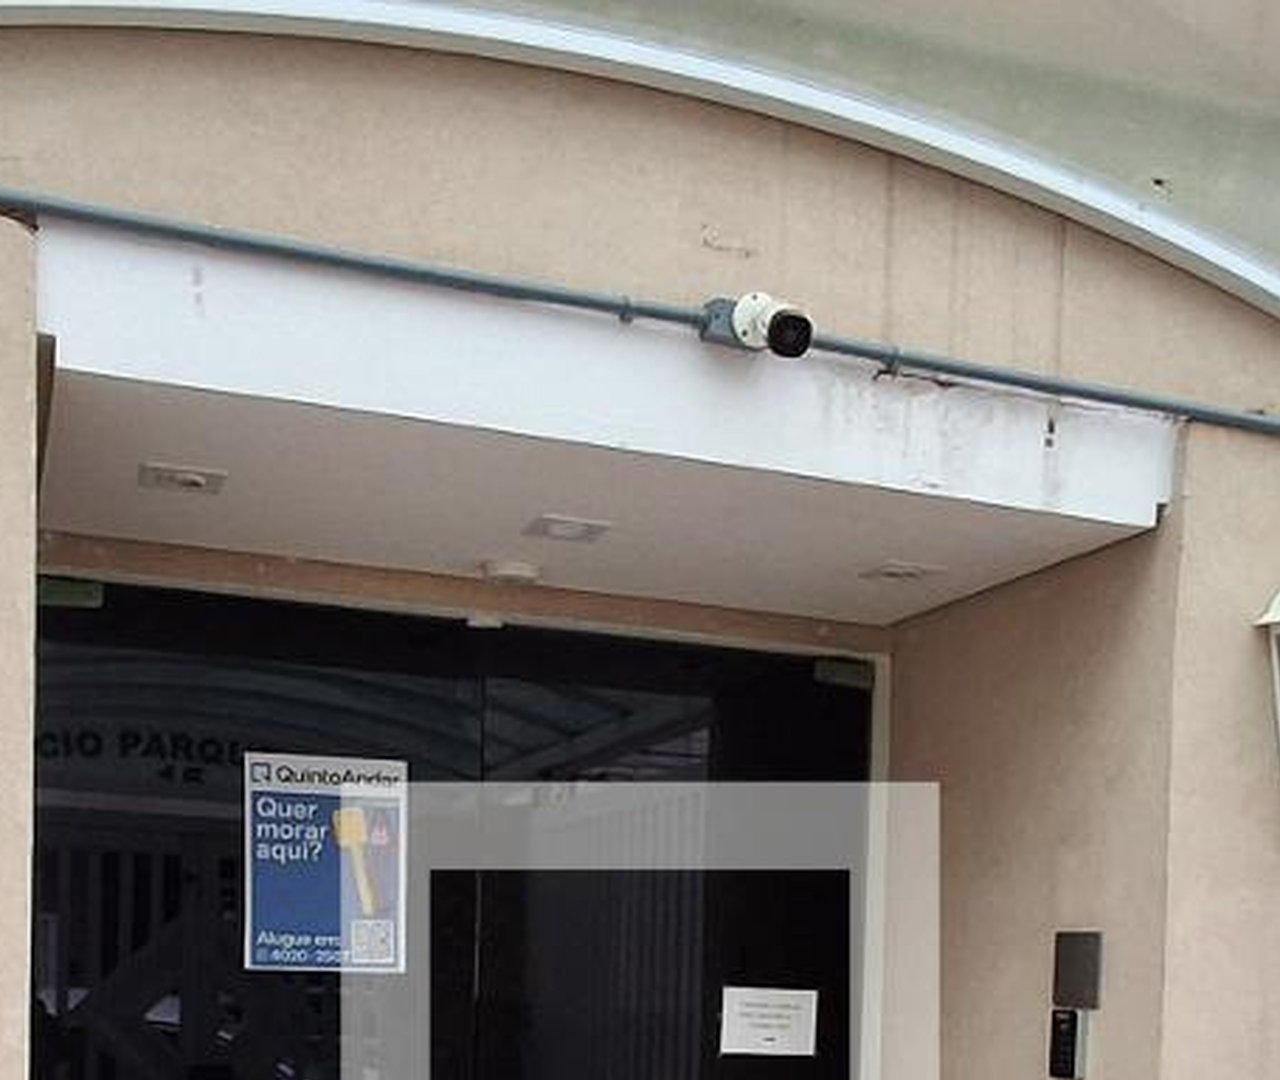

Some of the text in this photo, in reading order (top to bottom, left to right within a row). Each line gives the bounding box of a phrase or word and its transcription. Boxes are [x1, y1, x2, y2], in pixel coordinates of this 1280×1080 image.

[256, 796, 318, 819] Quer
[256, 823, 327, 840] morar
[256, 841, 323, 865] aqui?
